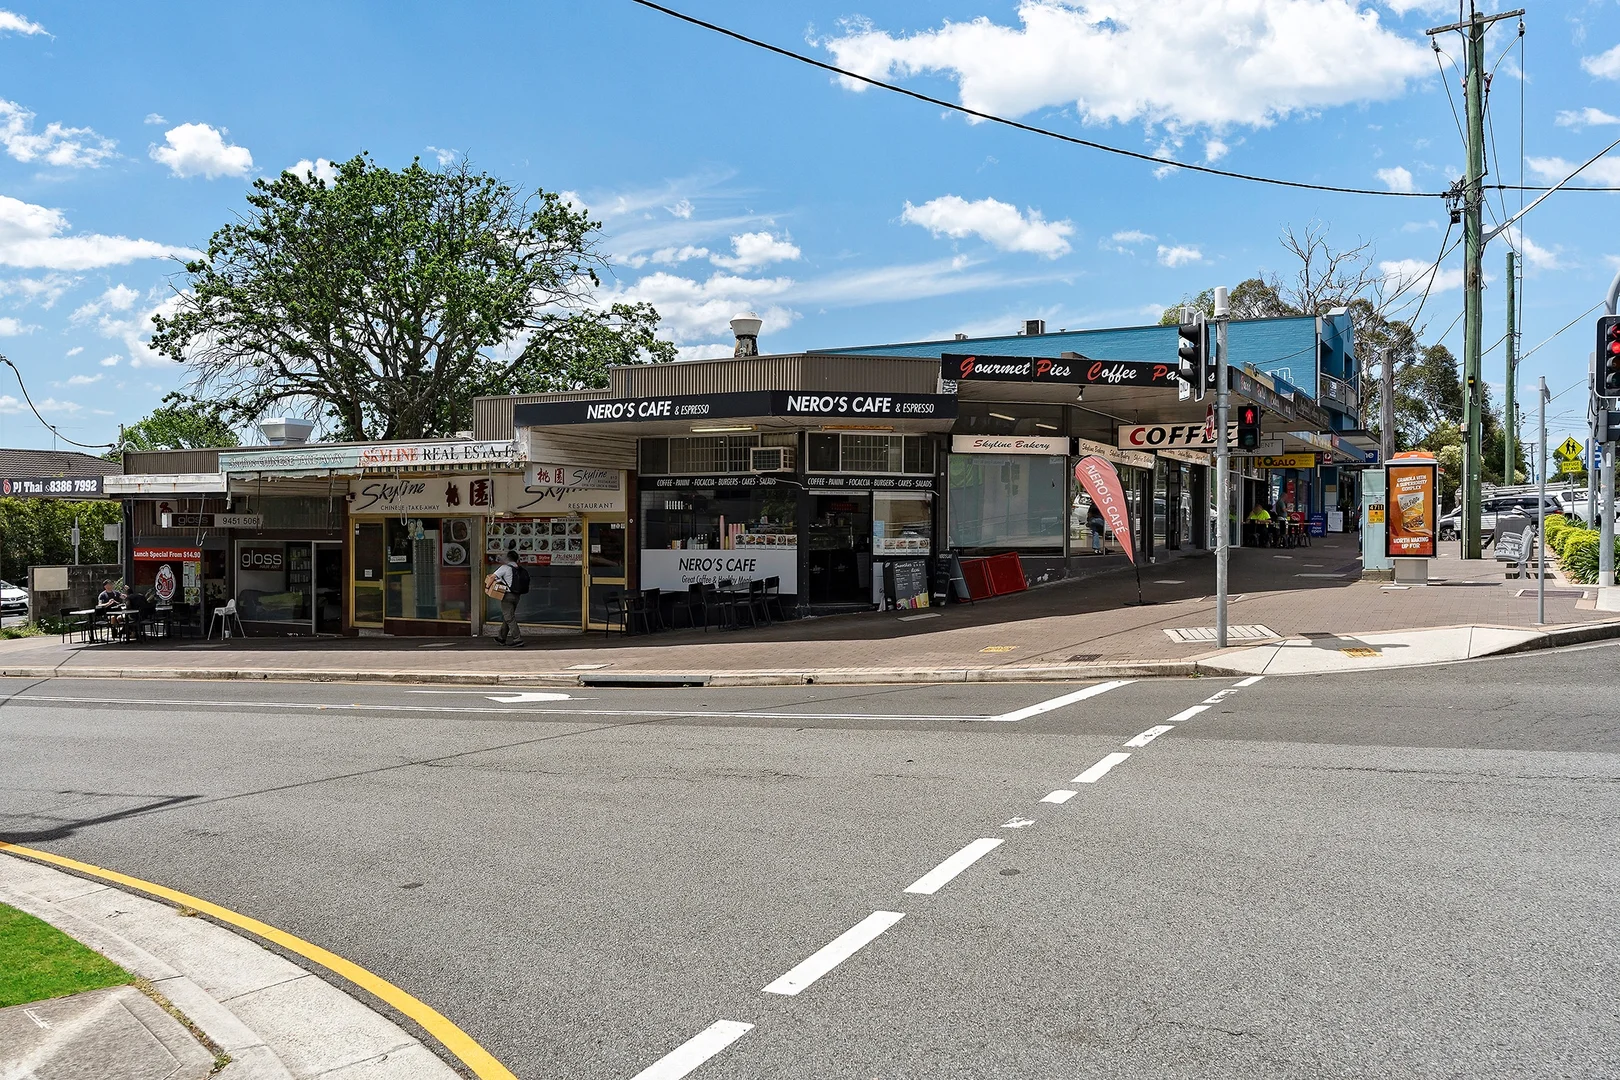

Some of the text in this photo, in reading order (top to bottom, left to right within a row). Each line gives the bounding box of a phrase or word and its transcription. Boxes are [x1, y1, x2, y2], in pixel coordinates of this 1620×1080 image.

[960, 356, 1031, 379] Gourmet
[1036, 359, 1071, 377] Pies
[1087, 361, 1137, 383] Coffee
[586, 400, 710, 420] NERO'S CAFE & ESPRESSO
[787, 395, 935, 414] NERO'S CAFE & ESPRESSO
[974, 440, 1050, 450] Skyline Bakery
[363, 447, 418, 462] SKYLINE
[423, 447, 459, 461] REAL
[569, 469, 608, 486] Skyline
[657, 479, 673, 487] COFFEE
[694, 478, 715, 486] FOCACCIA
[718, 478, 738, 486] BURGERS
[741, 477, 756, 486] CAKES
[807, 477, 825, 486] COFFEE
[848, 478, 871, 486] FOCACCIA
[873, 478, 895, 487] BURGERS
[898, 479, 912, 487] CAKES
[915, 479, 932, 488] SALADS
[1086, 464, 1113, 505] NERO'S
[12, 479, 97, 493] PJ Thai 8386 7992
[356, 479, 426, 511] Skyline
[177, 514, 208, 526] gloss
[222, 517, 240, 525] 9451
[133, 550, 149, 558] Lunch
[150, 551, 168, 559] Special
[241, 549, 282, 568] gloss
[678, 557, 757, 572] NERO'S CAFE
[681, 574, 696, 584] Great
